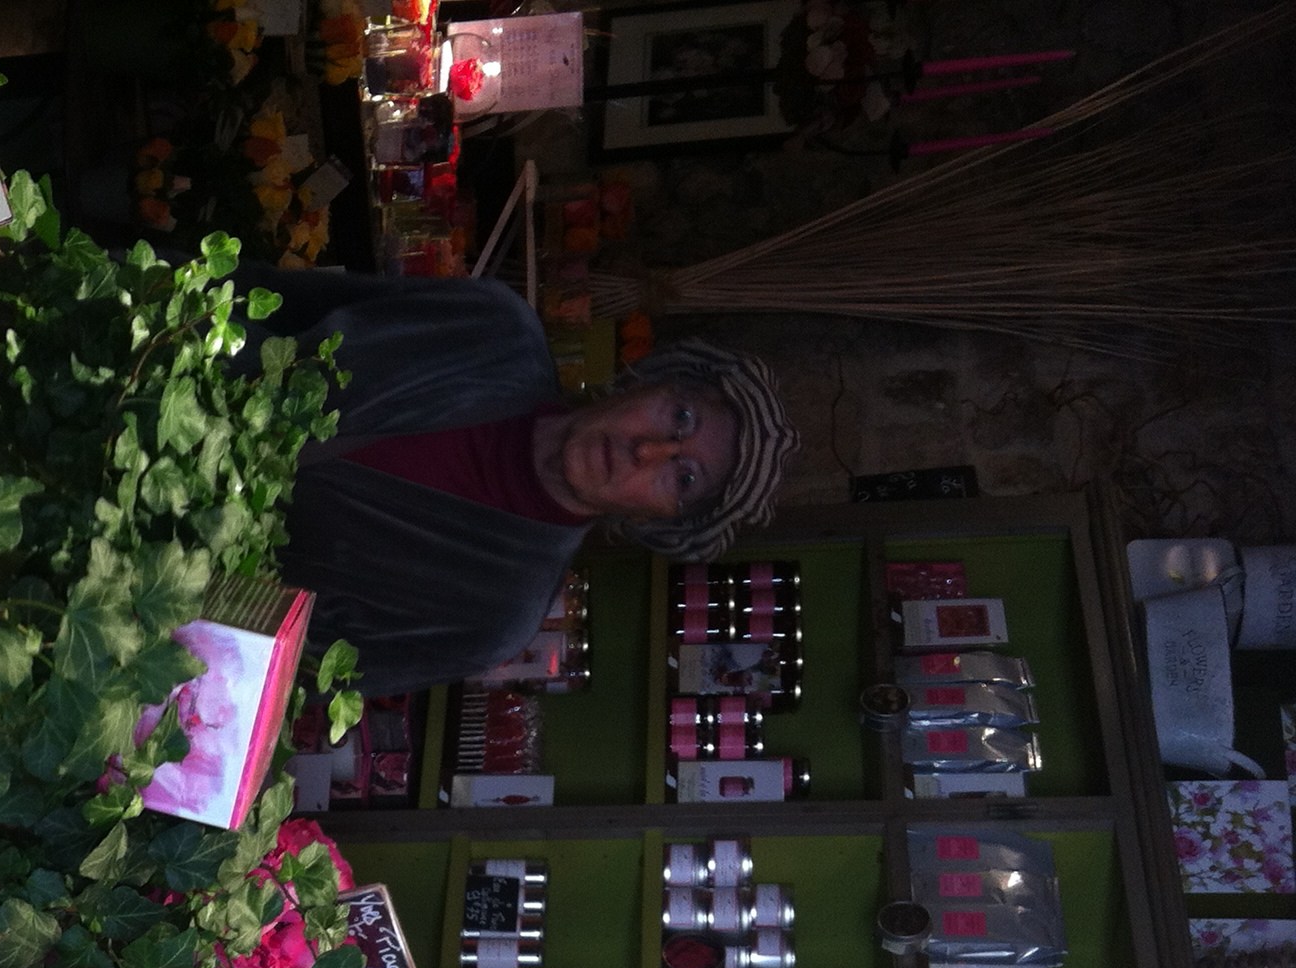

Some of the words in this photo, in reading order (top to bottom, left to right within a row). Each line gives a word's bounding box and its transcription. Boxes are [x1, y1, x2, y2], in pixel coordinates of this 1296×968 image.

[1164, 640, 1178, 688] GARDEN
[1182, 630, 1208, 695] FLOWERS
[345, 894, 386, 926] Yves
